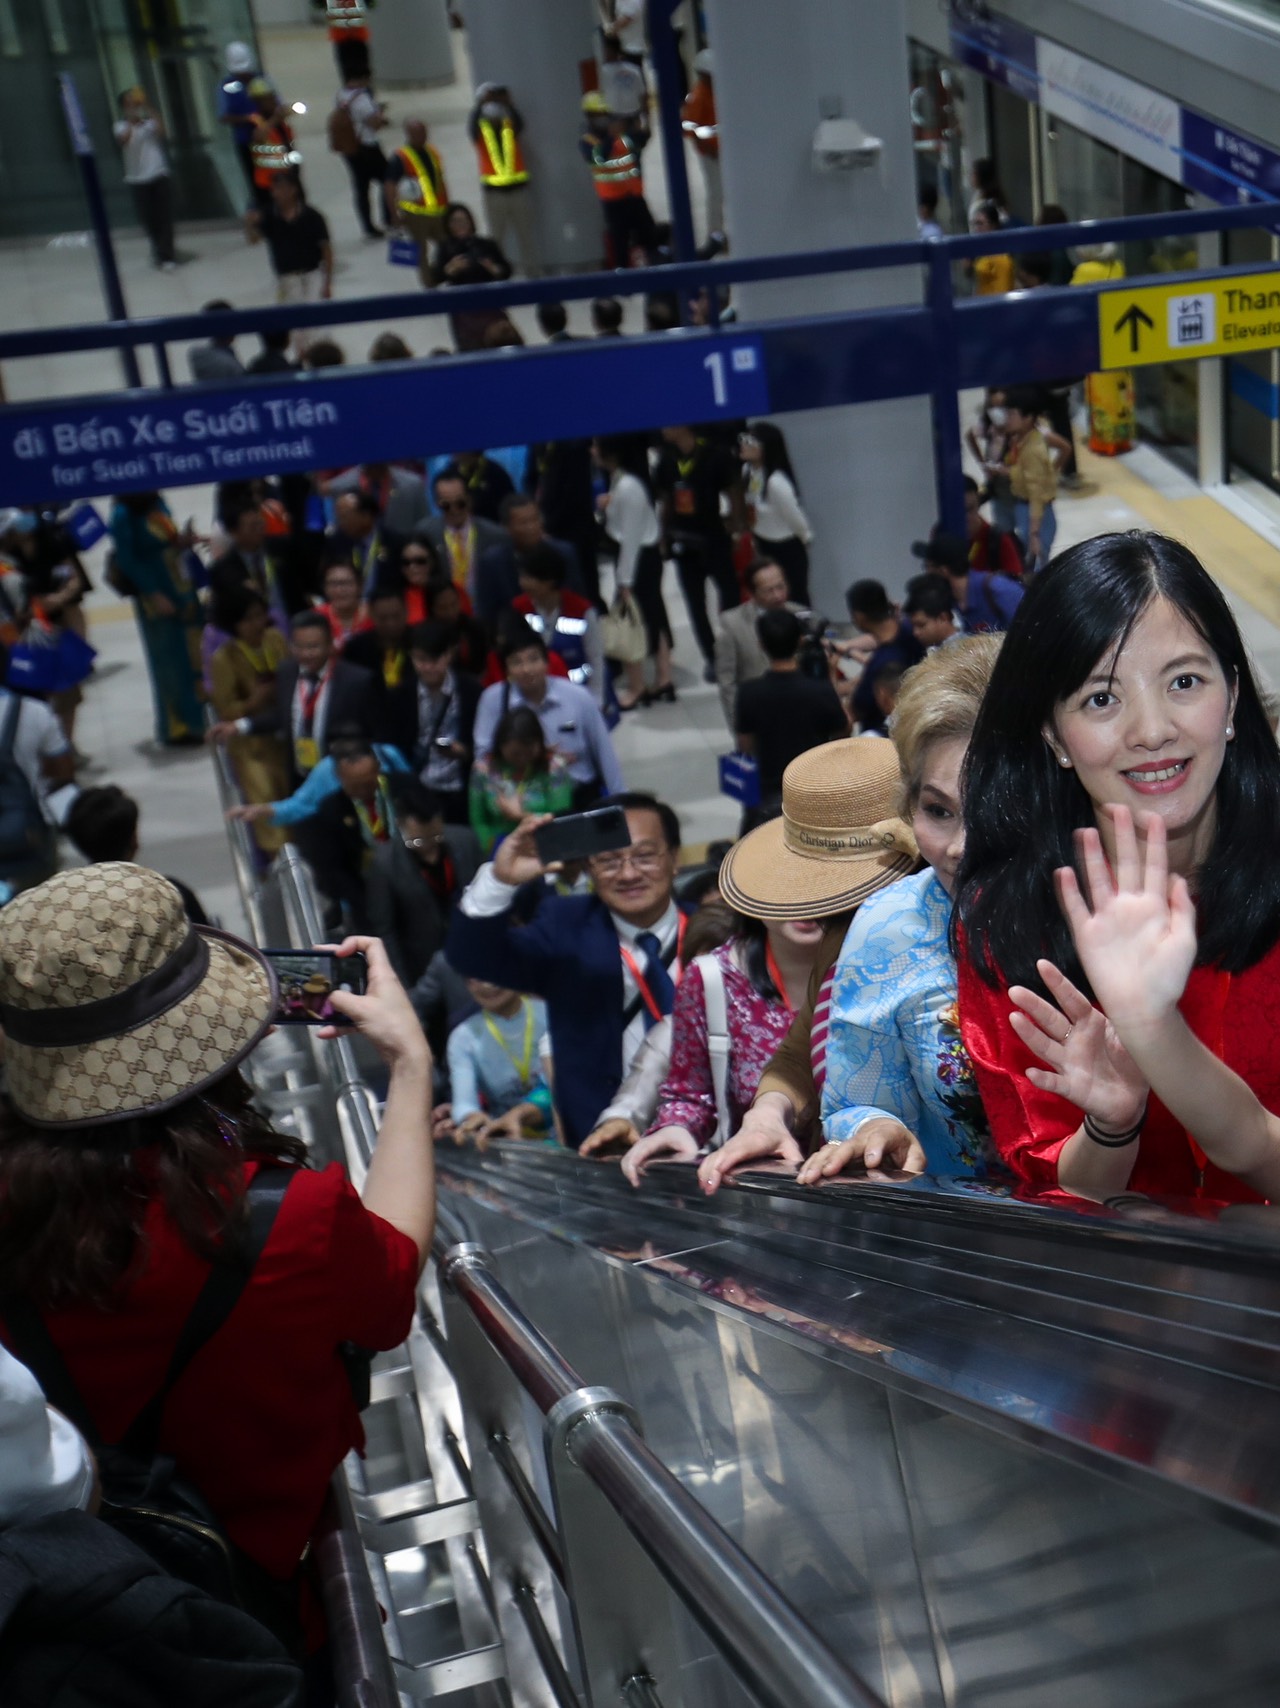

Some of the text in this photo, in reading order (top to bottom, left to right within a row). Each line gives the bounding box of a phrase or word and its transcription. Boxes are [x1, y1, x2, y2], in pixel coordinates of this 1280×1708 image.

[703, 351, 727, 407] 1
[13, 397, 338, 459] đi Bến Xe Suối Tiên
[52, 438, 313, 486] for Suoi Tien Terminal
[800, 831, 874, 848] Christian Dior
